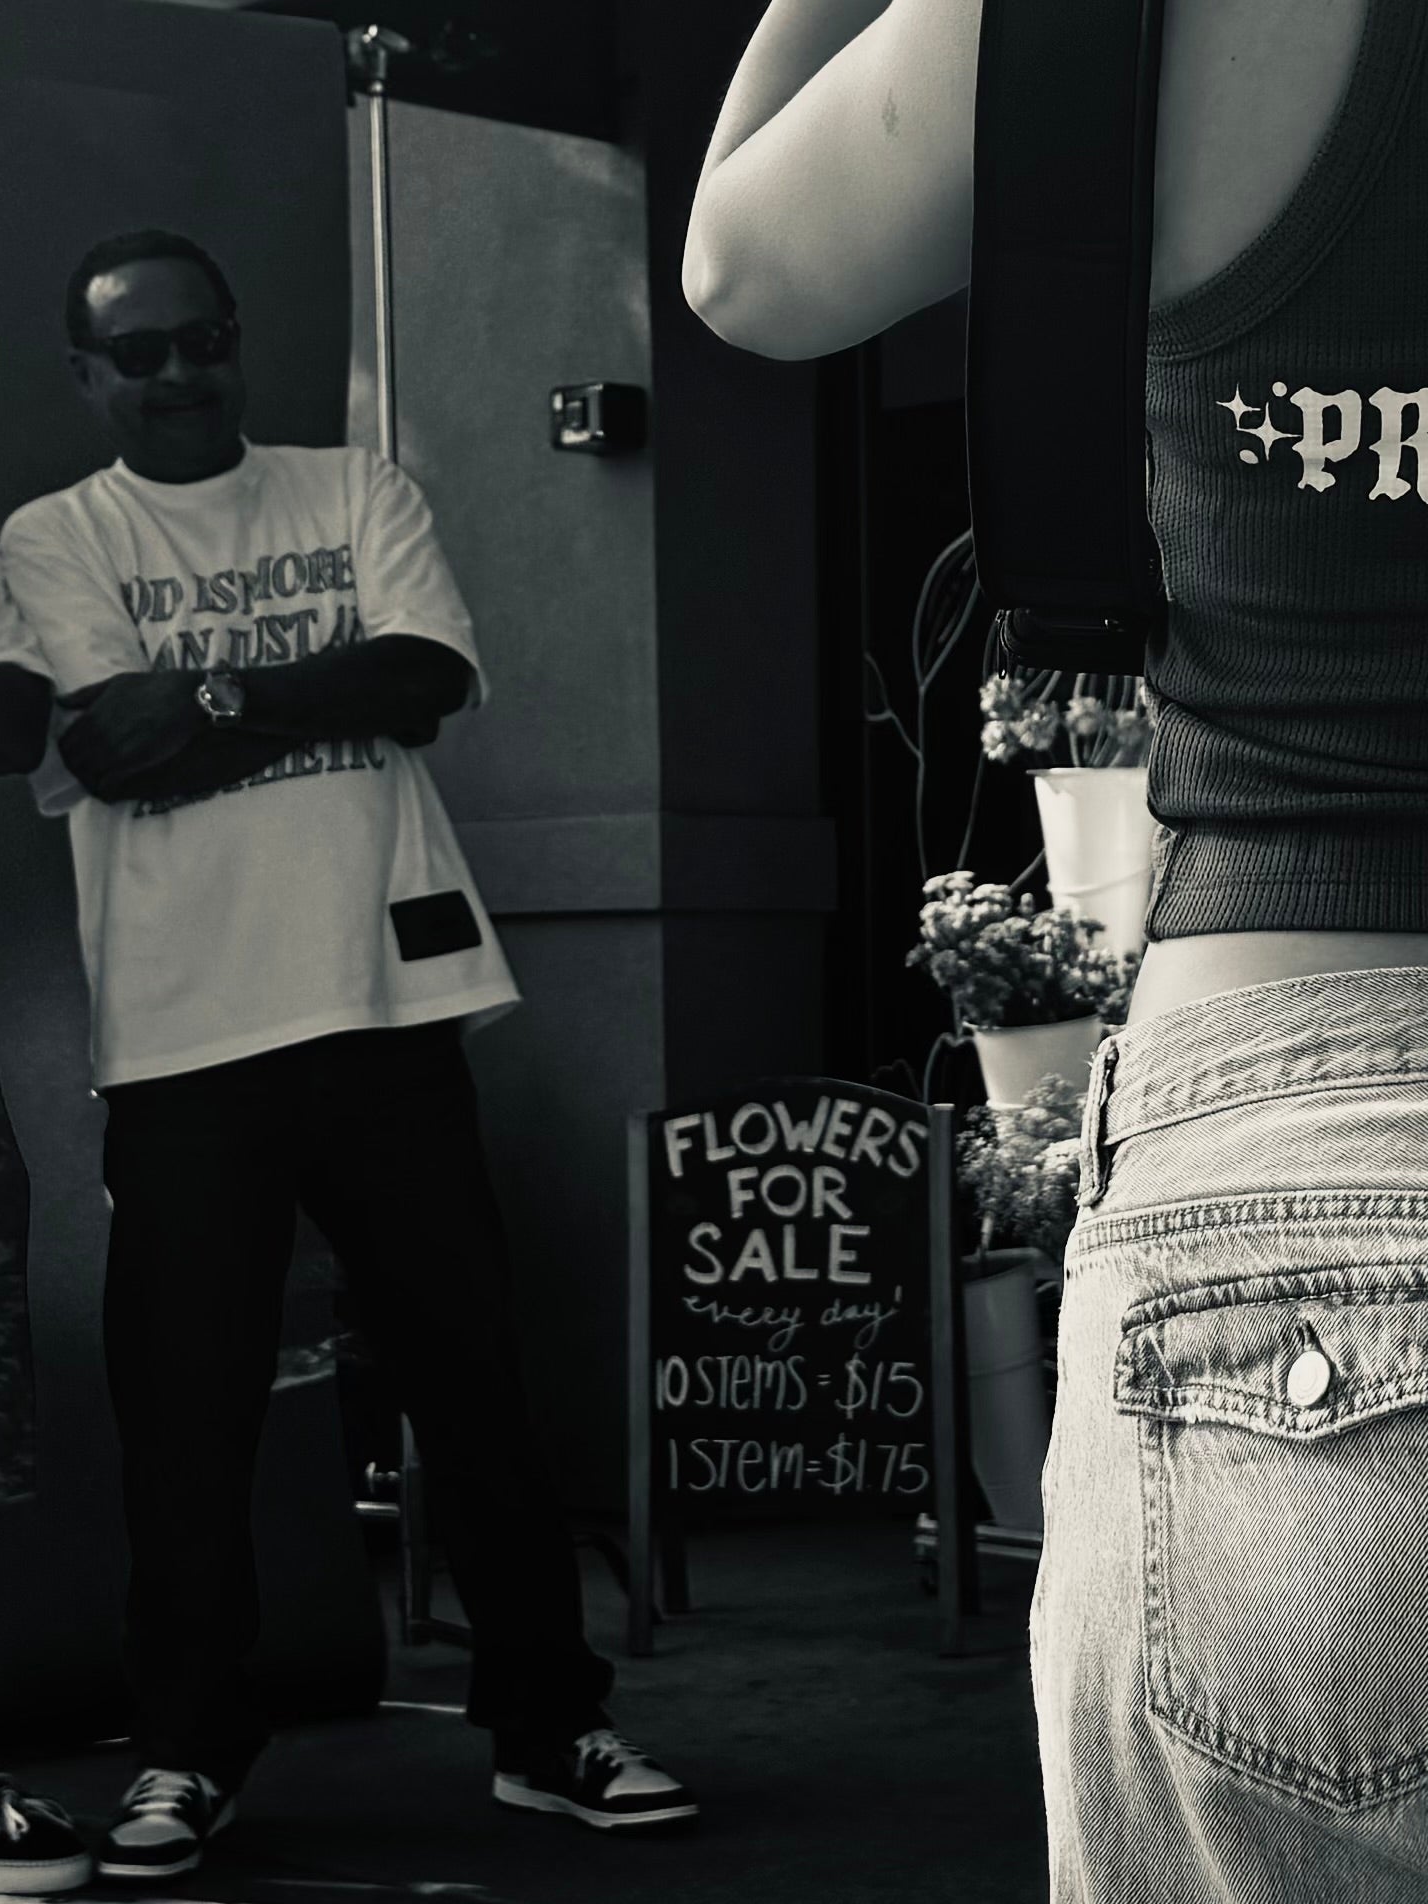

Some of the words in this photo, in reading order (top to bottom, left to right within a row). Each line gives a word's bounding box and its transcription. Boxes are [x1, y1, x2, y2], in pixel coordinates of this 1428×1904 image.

[120, 576, 184, 626] OD
[193, 570, 237, 615] IS
[239, 544, 356, 614] MORE
[663, 1095, 930, 1178] FLOWERS
[726, 1164, 853, 1221] FOR
[683, 1221, 872, 1284] SALE
[681, 1295, 805, 1353] every
[834, 1351, 925, 1420] $15
